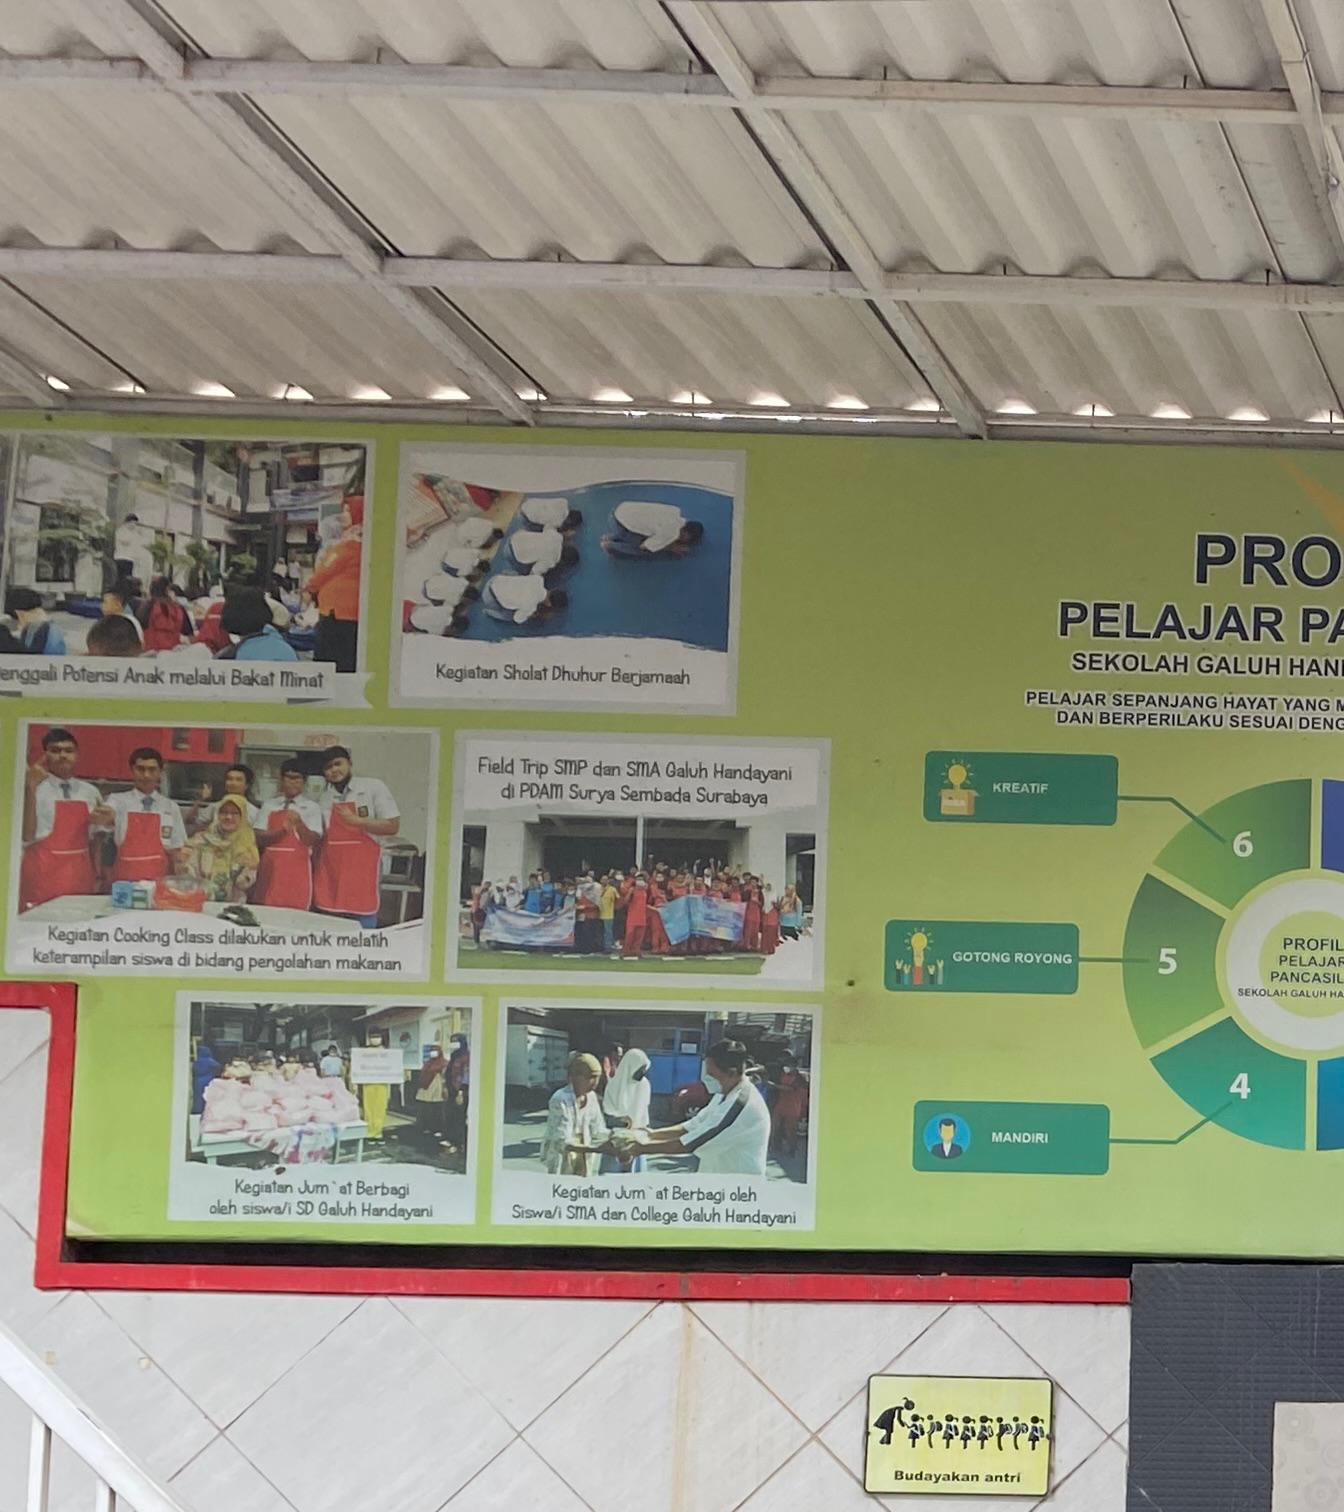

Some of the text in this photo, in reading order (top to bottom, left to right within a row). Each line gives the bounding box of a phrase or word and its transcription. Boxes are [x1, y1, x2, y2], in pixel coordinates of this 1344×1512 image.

[1057, 600, 1285, 643] PELAJAR
[1072, 652, 1188, 674] SEKOLAH
[1196, 655, 1280, 676] GALUH
[0, 664, 323, 688] enggali Potensi Anak melalui Bakat Minat
[436, 664, 690, 687] Kegiatan Sholat Dhuhur Berjamaah
[1025, 690, 1107, 707] PELAJAR
[1112, 693, 1217, 709] SEPANJANG
[1223, 696, 1277, 711] HAYAT
[1284, 697, 1330, 713] YANG
[1057, 710, 1093, 725] DAN
[1099, 711, 1224, 729] BERPERILAKU
[1229, 714, 1294, 730] SESUAI
[478, 757, 792, 784] Field Trip SMP dan SMA Galuh Handayani
[501, 783, 767, 807] di PDAM Surya Sembada Surabaya
[992, 782, 1048, 794] KREATIF
[1232, 830, 1254, 857] 6
[48, 926, 388, 948] Kegiatan Cooking Class dilakukan untuk melatih
[1283, 937, 1344, 951] PROFIL
[33, 949, 401, 973] keterampilan siswa di bidang pengolahan makanan
[952, 951, 1073, 965] GOTONG ROYONG
[1158, 947, 1177, 975] 5
[1238, 988, 1287, 997] SEKOLAH
[1290, 989, 1327, 998] GALUH
[1229, 1072, 1251, 1099] 4
[991, 1132, 1049, 1144] MANDIRI
[235, 1179, 293, 1197] Kegiatan
[356, 1181, 409, 1199] Berbagi
[552, 1184, 610, 1201] Kegiatan
[672, 1187, 725, 1205] Berbagi
[730, 1187, 757, 1202] oleh
[209, 1200, 433, 1220] oleh siswa/i SD Galuh Handayani
[512, 1205, 796, 1227] Siswa/i SMA dan College Galuh Handayani
[894, 1470, 1021, 1484] Budayakan antri
